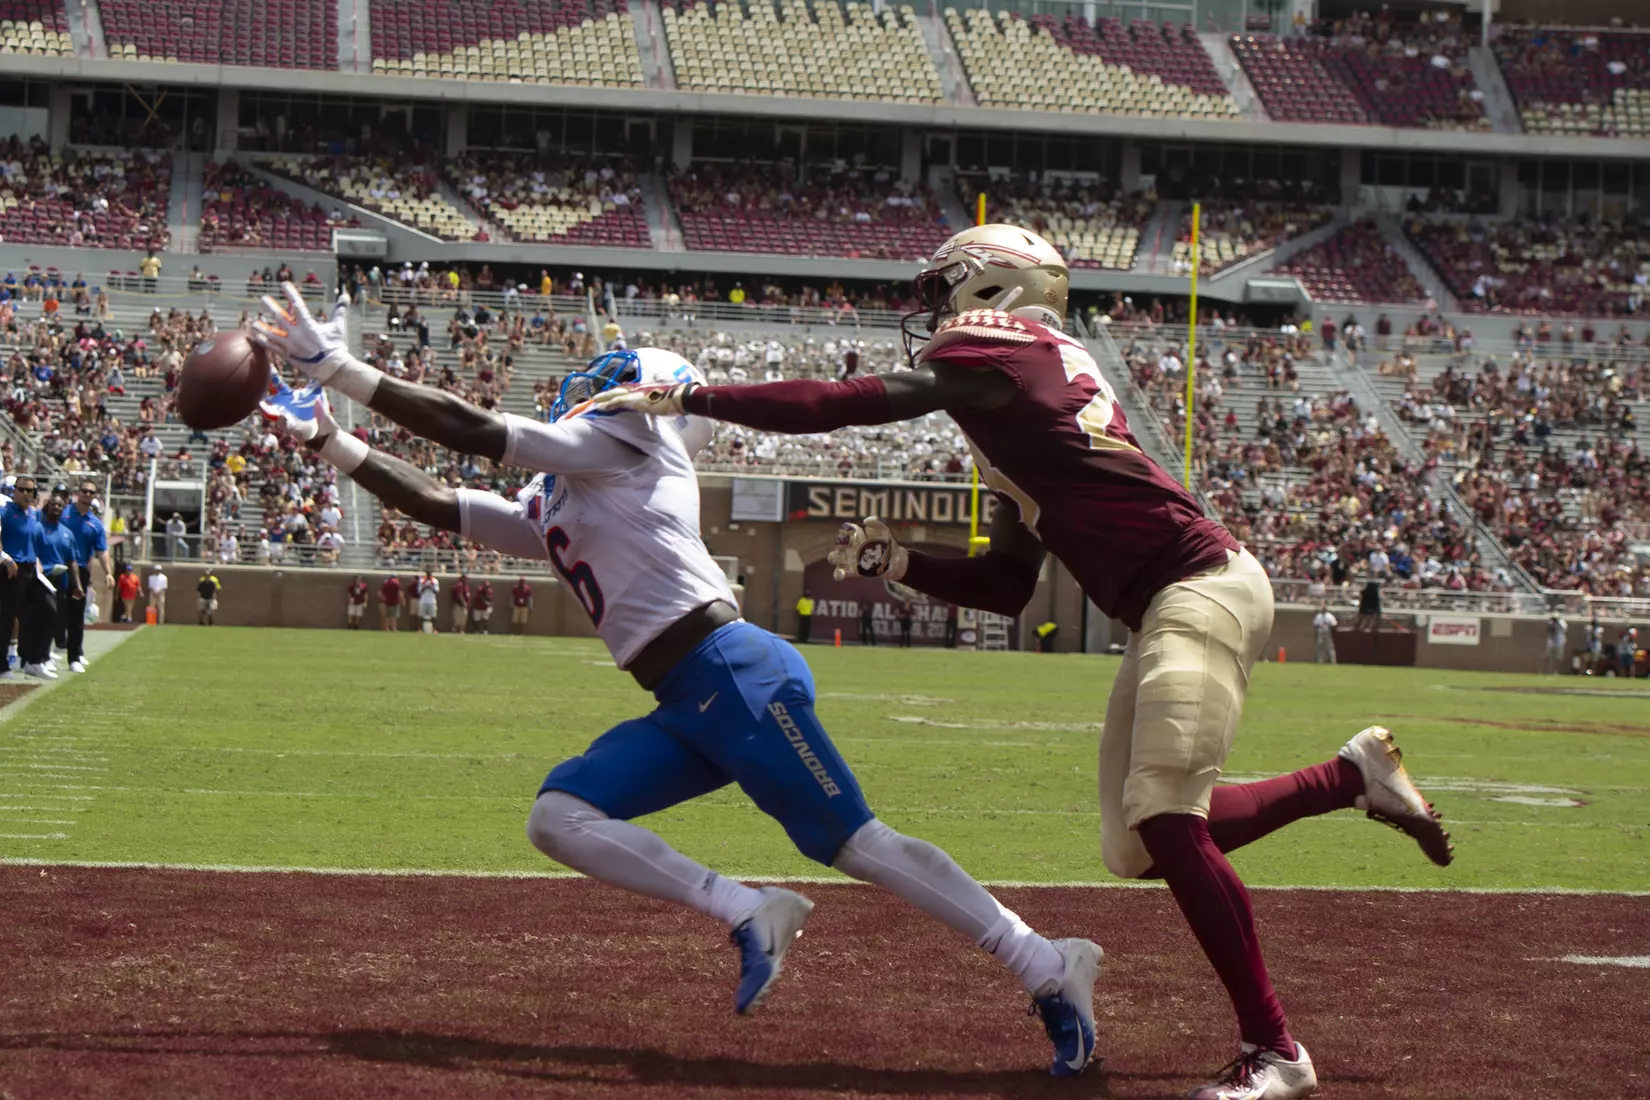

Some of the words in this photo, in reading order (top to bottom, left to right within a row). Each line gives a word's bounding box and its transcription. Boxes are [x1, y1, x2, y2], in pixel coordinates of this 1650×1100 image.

[546, 526, 605, 630] 6
[814, 599, 896, 620] ATIOAL
[768, 702, 842, 799] BRONCOS
